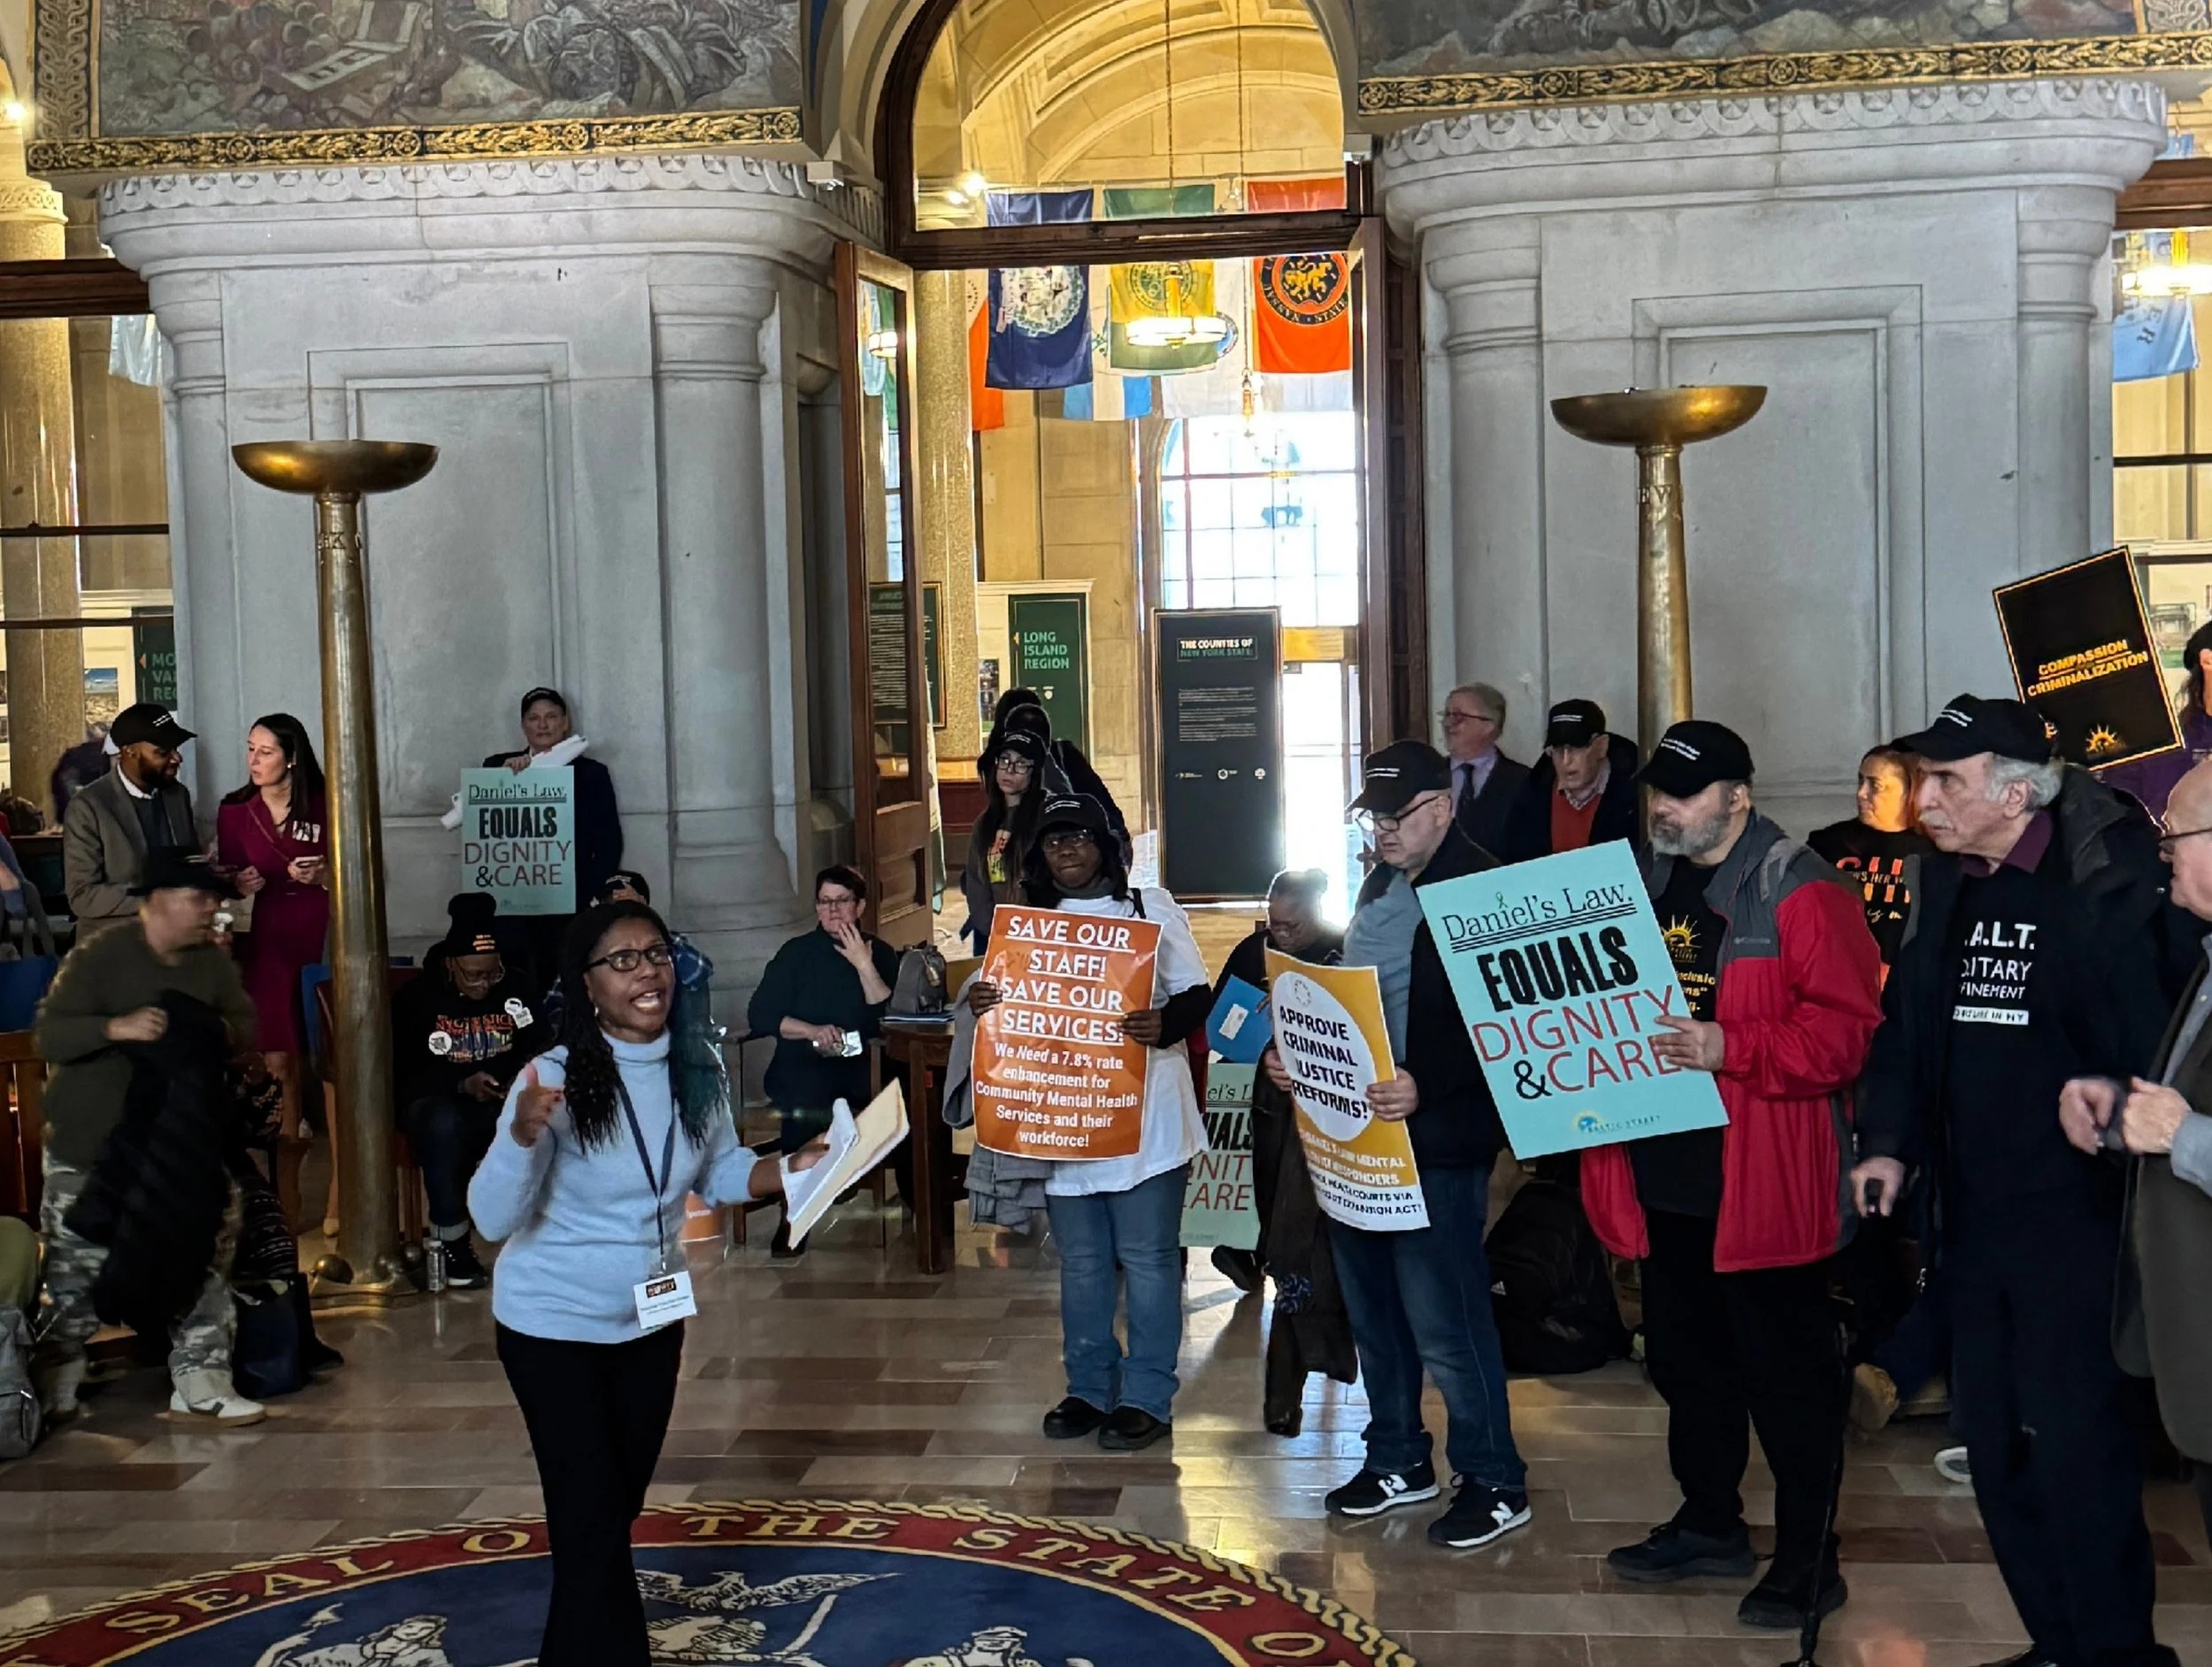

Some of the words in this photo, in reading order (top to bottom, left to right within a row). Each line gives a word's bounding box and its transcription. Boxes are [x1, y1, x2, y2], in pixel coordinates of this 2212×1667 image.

[1024, 632, 1056, 643] LONG
[1025, 644, 1067, 656] ISLAND
[1180, 640, 1197, 649] THE
[1198, 639, 1240, 649] COUNTIES
[1241, 638, 1253, 647] OF
[1025, 657, 1069, 669] REGION
[2039, 640, 2128, 676] COMPASSION
[2028, 651, 2148, 697] CRIMINALIZATION
[469, 782, 527, 798] Daniel's
[479, 806, 557, 840] EQUALS
[465, 841, 572, 864] DIGNITY
[1442, 892, 1556, 941] Daniel's
[1562, 884, 1633, 914] Law.
[1008, 916, 1070, 941] SAVE
[1076, 923, 1130, 949] OUR
[1029, 949, 1107, 977] STAFF!
[1477, 926, 1639, 1012] EQUALS
[1001, 977, 1062, 1004] SAVE
[1069, 986, 1124, 1011] OUR
[1279, 1005, 1349, 1041] APPROVE
[1471, 985, 1672, 1063] DIGNITY
[995, 1042, 1015, 1057] We
[1017, 1046, 1049, 1062] Need
[1051, 1054, 1059, 1064] a
[1063, 1051, 1093, 1069] 7.8%
[1096, 1057, 1124, 1070] rate
[1284, 1031, 1358, 1066] CRIMINAL
[1002, 1065, 1087, 1087] enhancement
[1091, 1073, 1111, 1088] for
[976, 1081, 1044, 1107] Community
[1047, 1090, 1092, 1108] Mental
[1097, 1093, 1138, 1109] Health
[1207, 1084, 1236, 1101] el's
[996, 1104, 1049, 1125] Services
[1054, 1112, 1078, 1127] and
[1081, 1114, 1113, 1128] their
[1019, 1130, 1089, 1148] workforce!
[1356, 1153, 1407, 1168] MENTAL
[1184, 1183, 1253, 1210] ARE
[105, 1556, 394, 1633] SEAL
[462, 1529, 531, 1555] O
[681, 1513, 902, 1540] THE
[952, 1527, 1256, 1613] STATE
